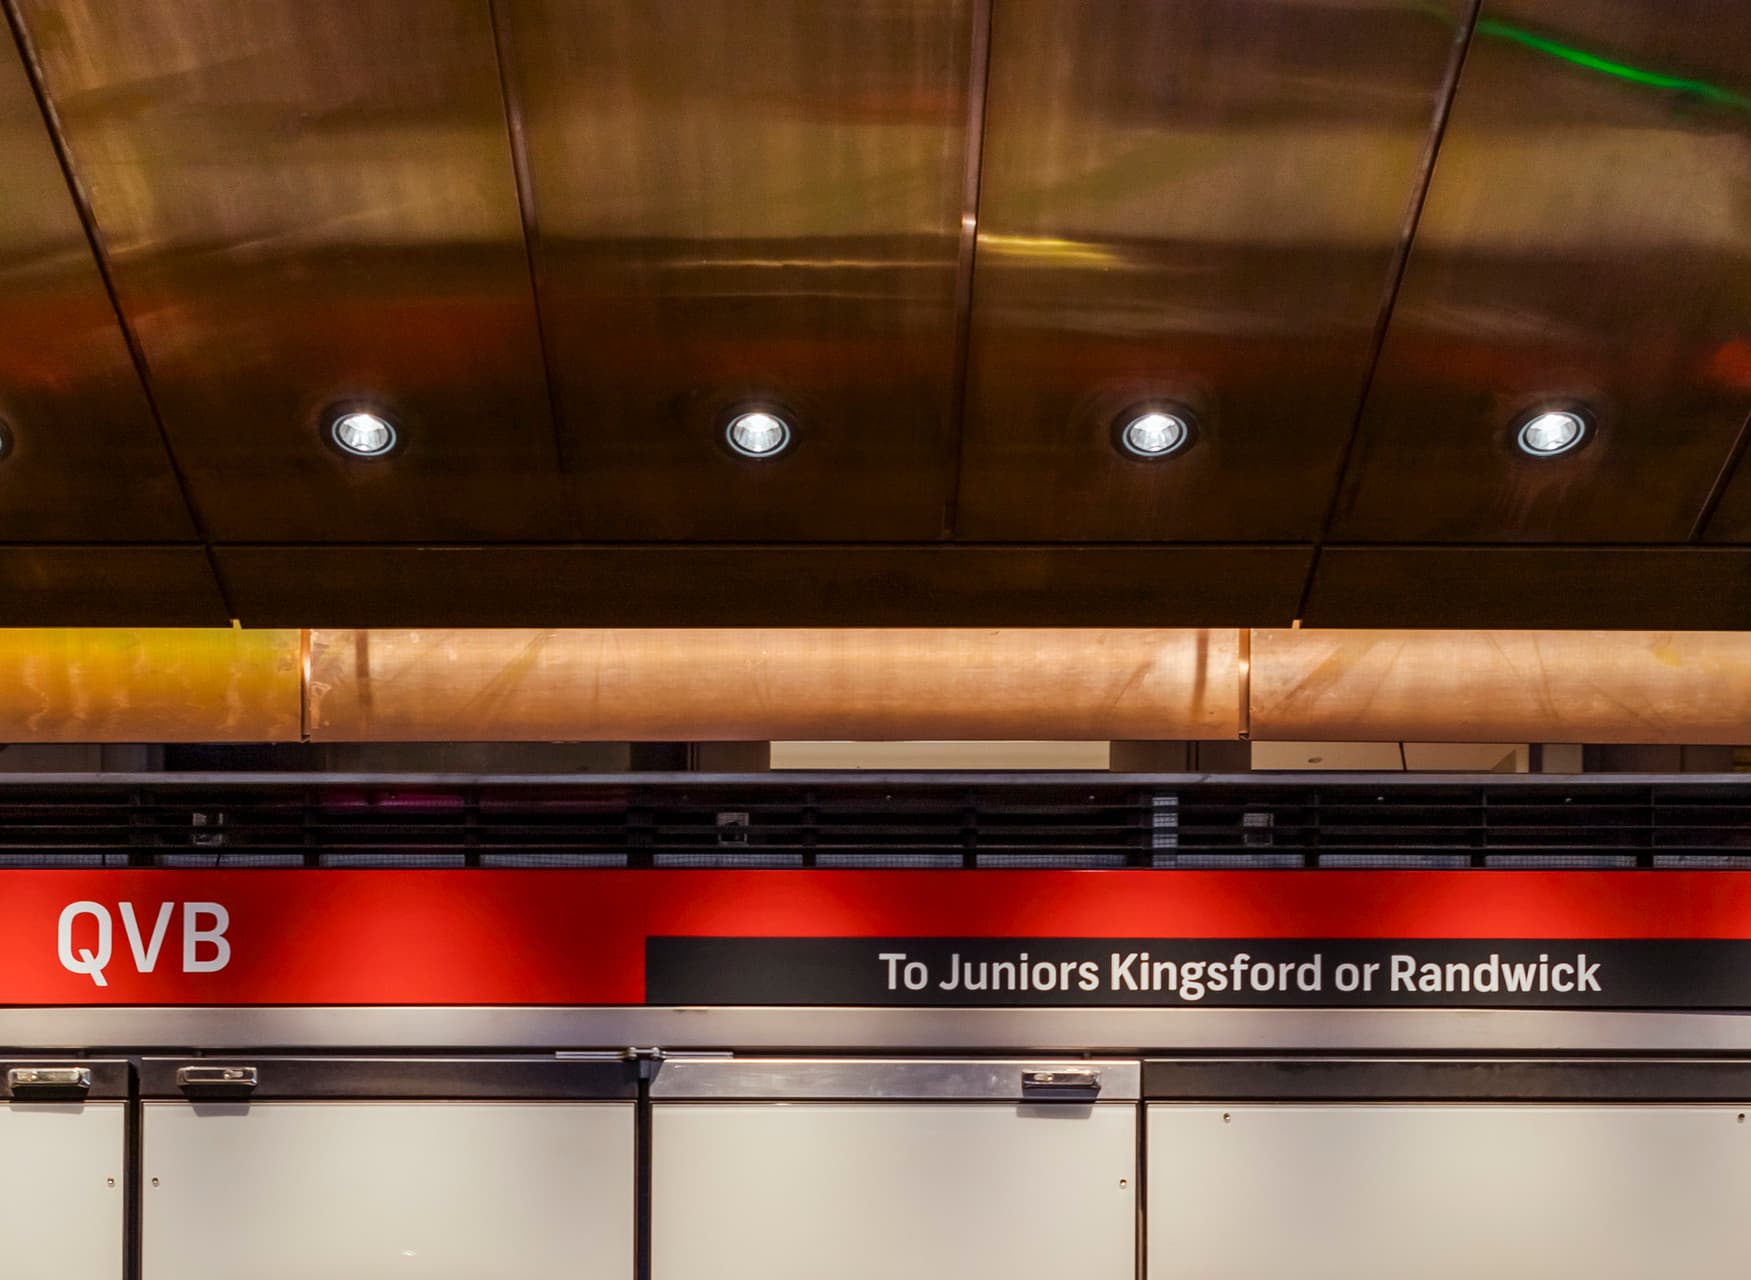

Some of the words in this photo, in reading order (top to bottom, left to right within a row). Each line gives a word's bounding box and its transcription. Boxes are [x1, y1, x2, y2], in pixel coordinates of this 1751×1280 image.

[57, 901, 232, 987] QVB
[879, 952, 928, 991] To
[939, 952, 1099, 992] Juniors
[1110, 953, 1322, 1001] Kingsford
[1335, 964, 1379, 992] or
[1390, 953, 1602, 993] Randwick
